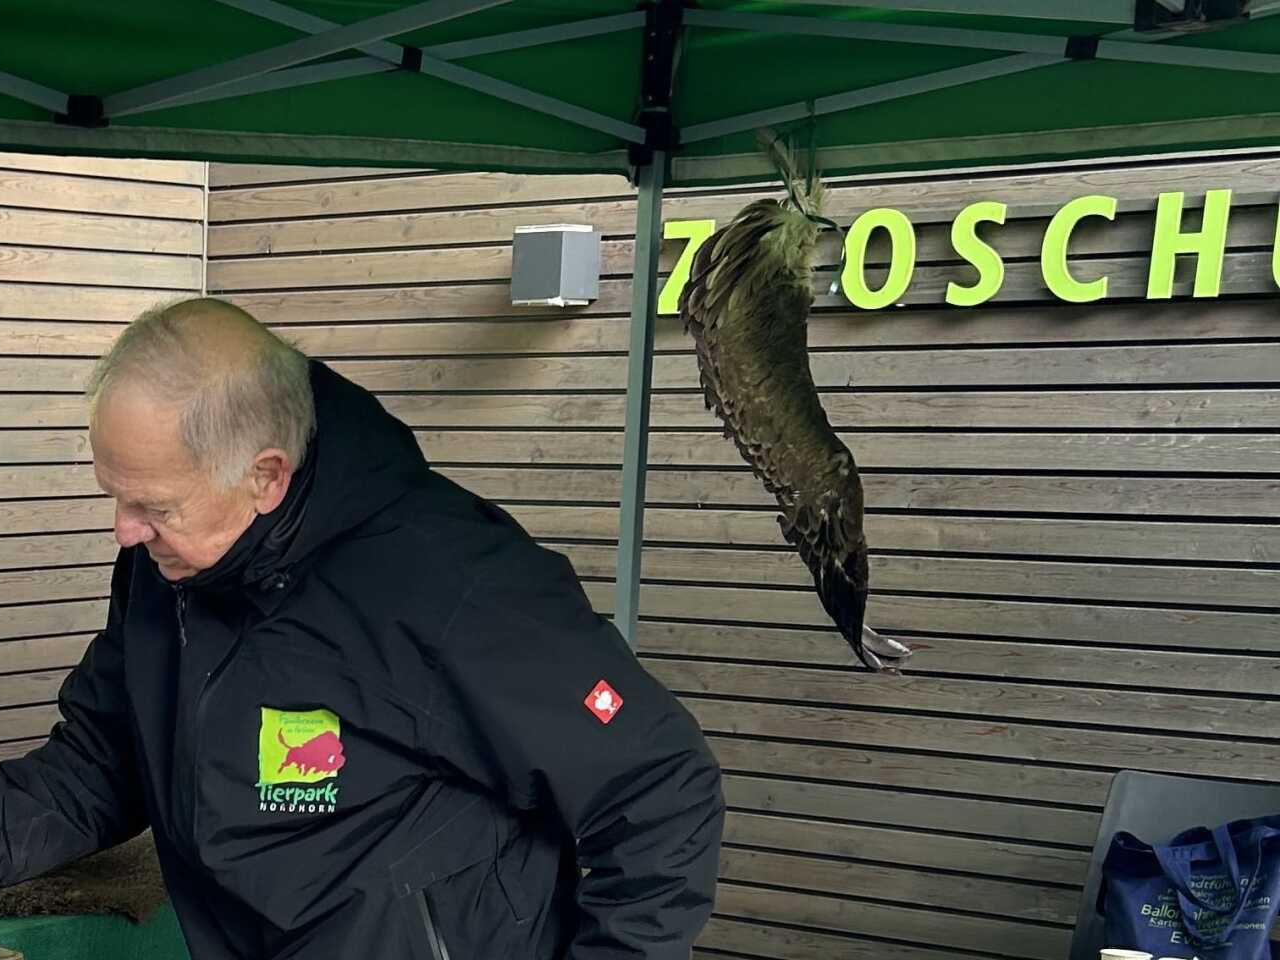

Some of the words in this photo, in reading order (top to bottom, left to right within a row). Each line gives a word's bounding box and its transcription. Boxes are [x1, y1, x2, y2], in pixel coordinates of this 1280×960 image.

[657, 188, 1280, 316] ZOSCH
[255, 782, 339, 805] Tierpark
[260, 802, 336, 813] NORDHORN
